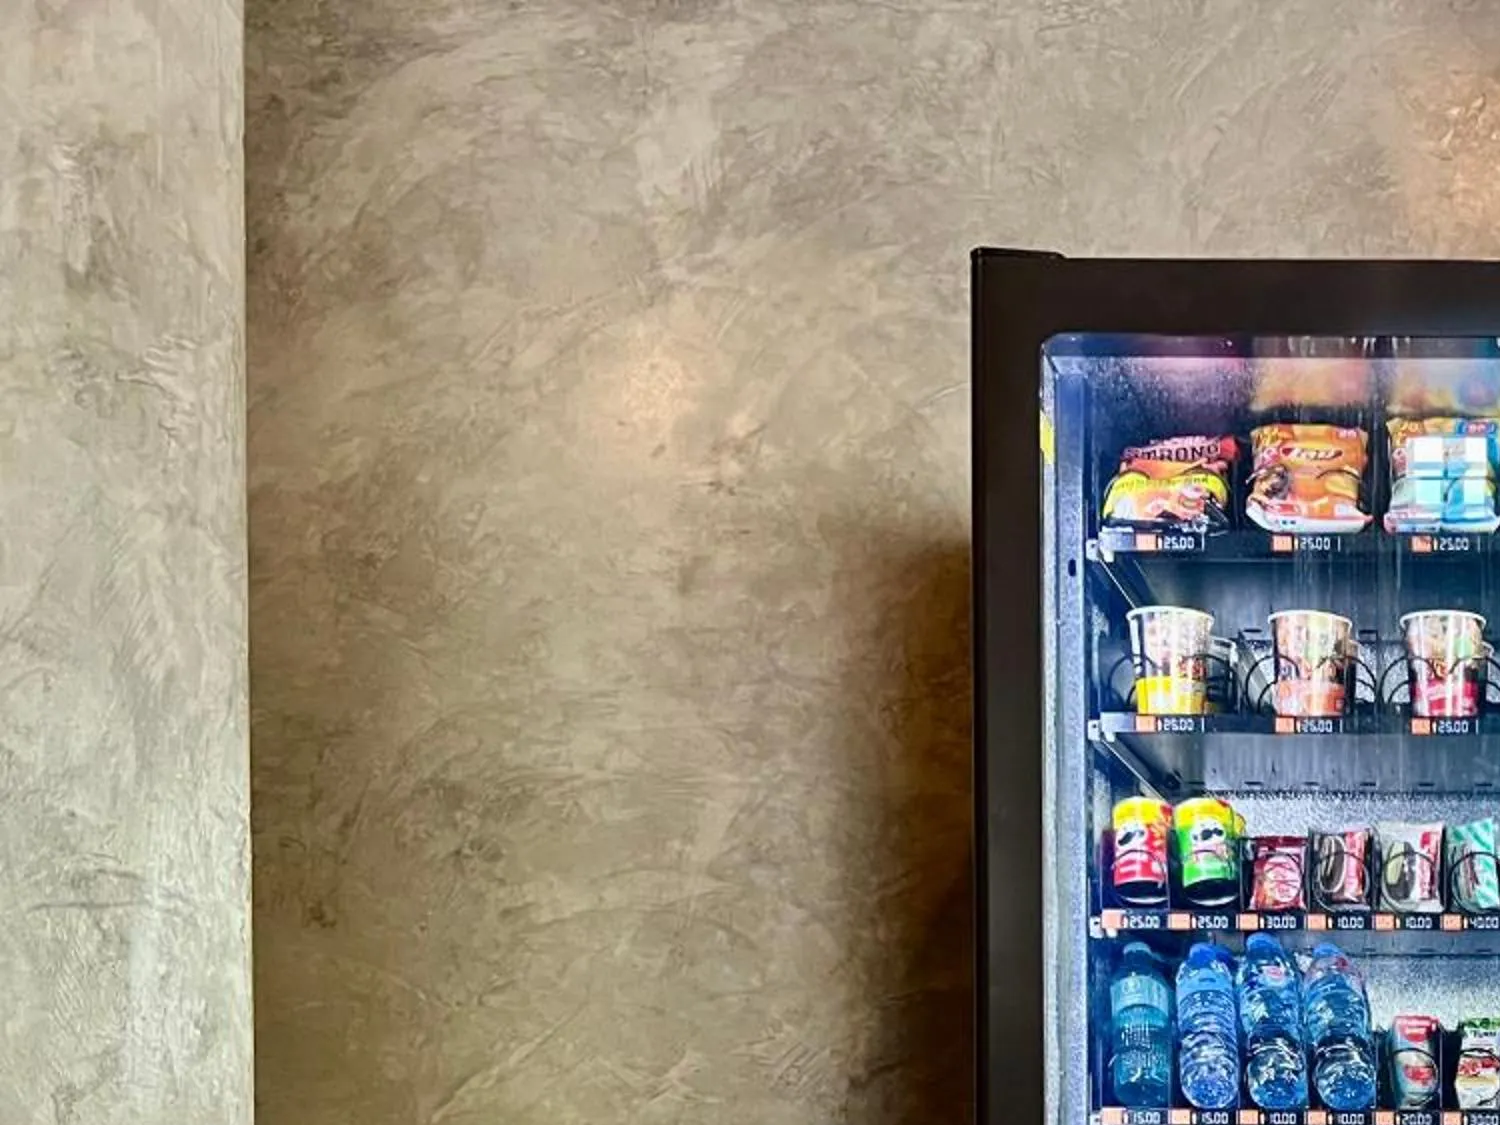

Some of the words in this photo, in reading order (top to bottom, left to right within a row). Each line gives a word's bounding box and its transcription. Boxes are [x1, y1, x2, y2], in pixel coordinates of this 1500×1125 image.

[1163, 536, 1196, 550] 25.00
[1300, 537, 1332, 551] 25.00
[1439, 537, 1470, 551] 25.00
